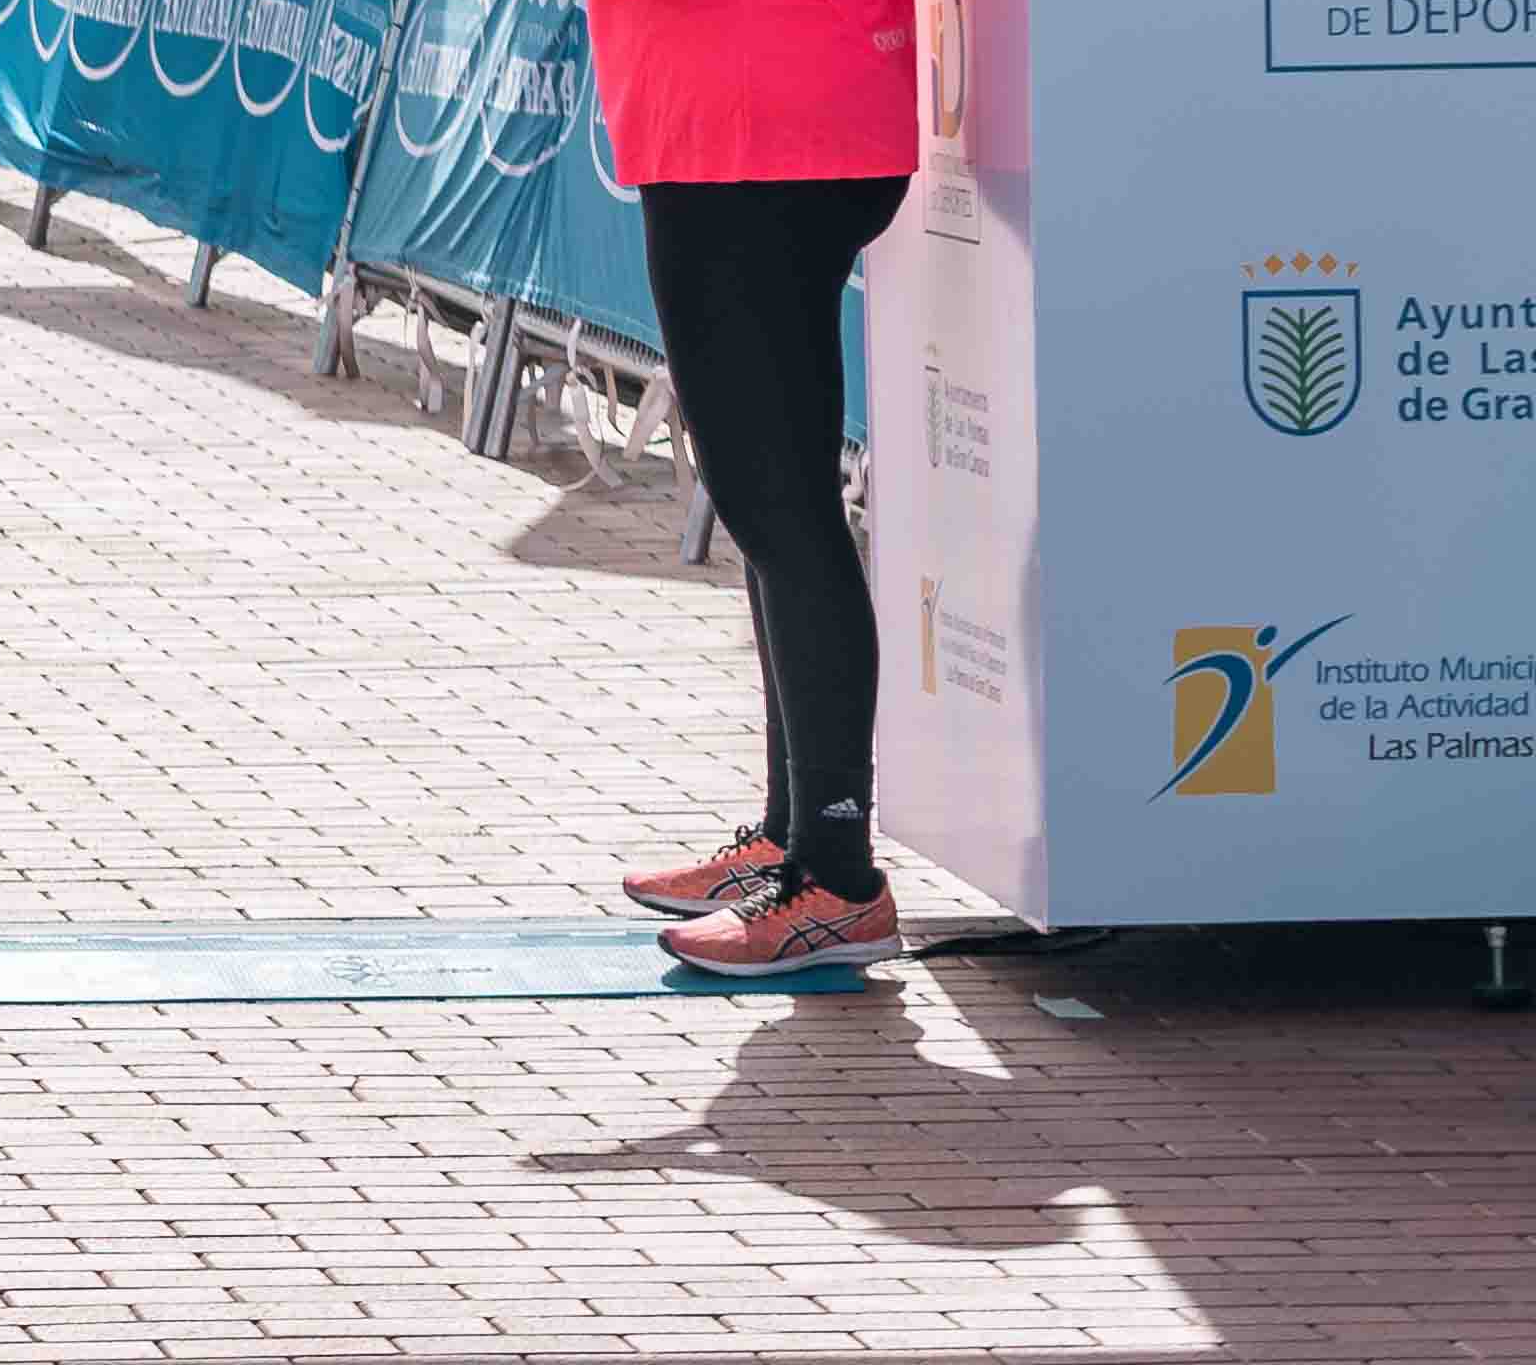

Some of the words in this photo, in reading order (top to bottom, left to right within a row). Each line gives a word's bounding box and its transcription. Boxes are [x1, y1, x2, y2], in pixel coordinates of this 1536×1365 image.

[1397, 341, 1449, 377] de
[1398, 385, 1449, 423] de
[1316, 657, 1430, 685] Instituto
[1396, 690, 1529, 720] Actividad
[1368, 733, 1417, 762] Las
[1427, 730, 1534, 760] Palmas
